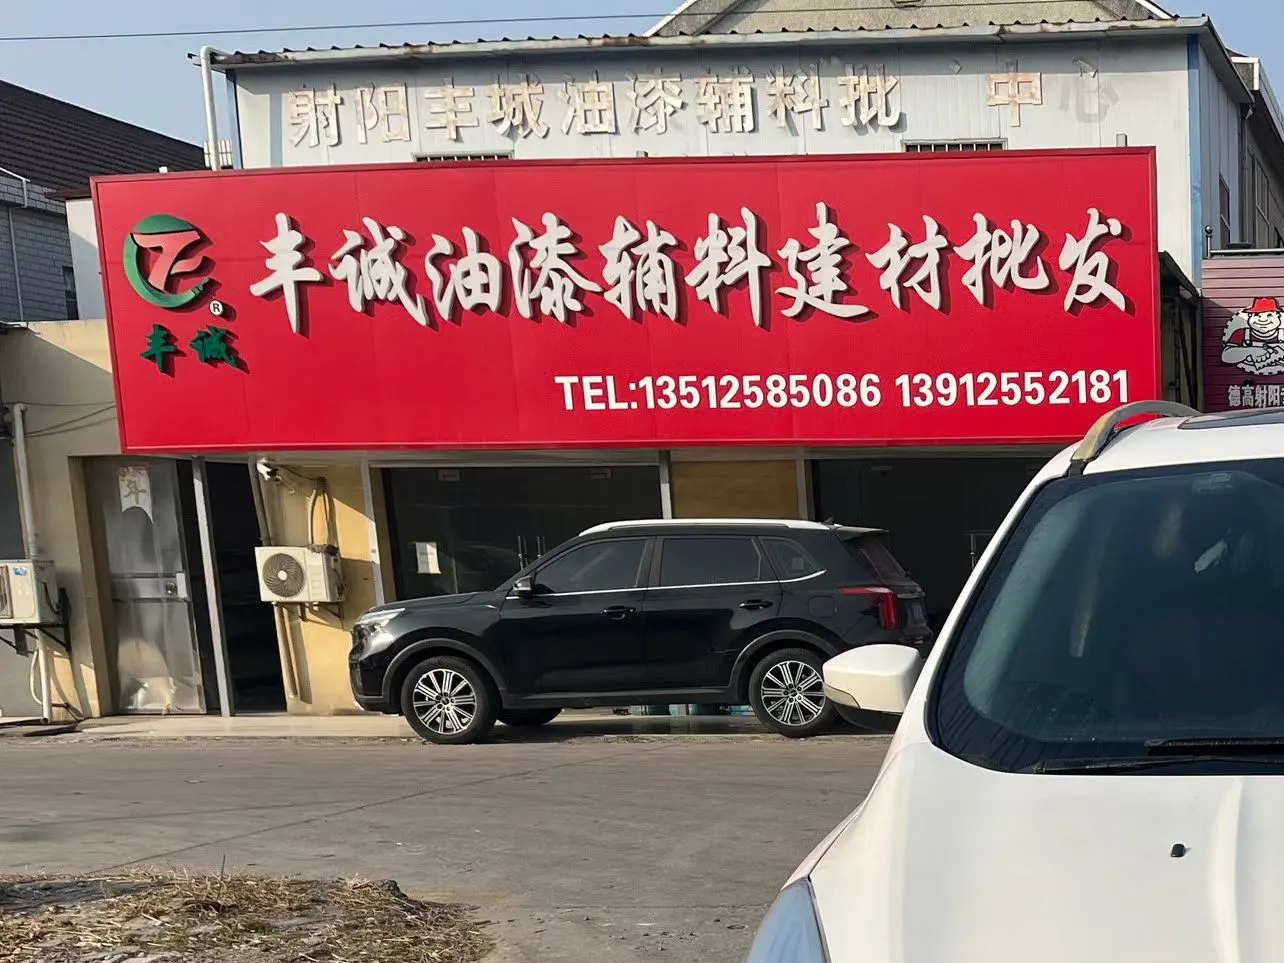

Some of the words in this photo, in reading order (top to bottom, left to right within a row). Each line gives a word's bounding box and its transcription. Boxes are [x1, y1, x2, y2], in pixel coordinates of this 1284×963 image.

[250, 202, 1126, 332] 丰诚油漆辅料建材批发
[555, 373, 881, 410] TEL:13512585086
[900, 370, 1129, 407] 13912552181
